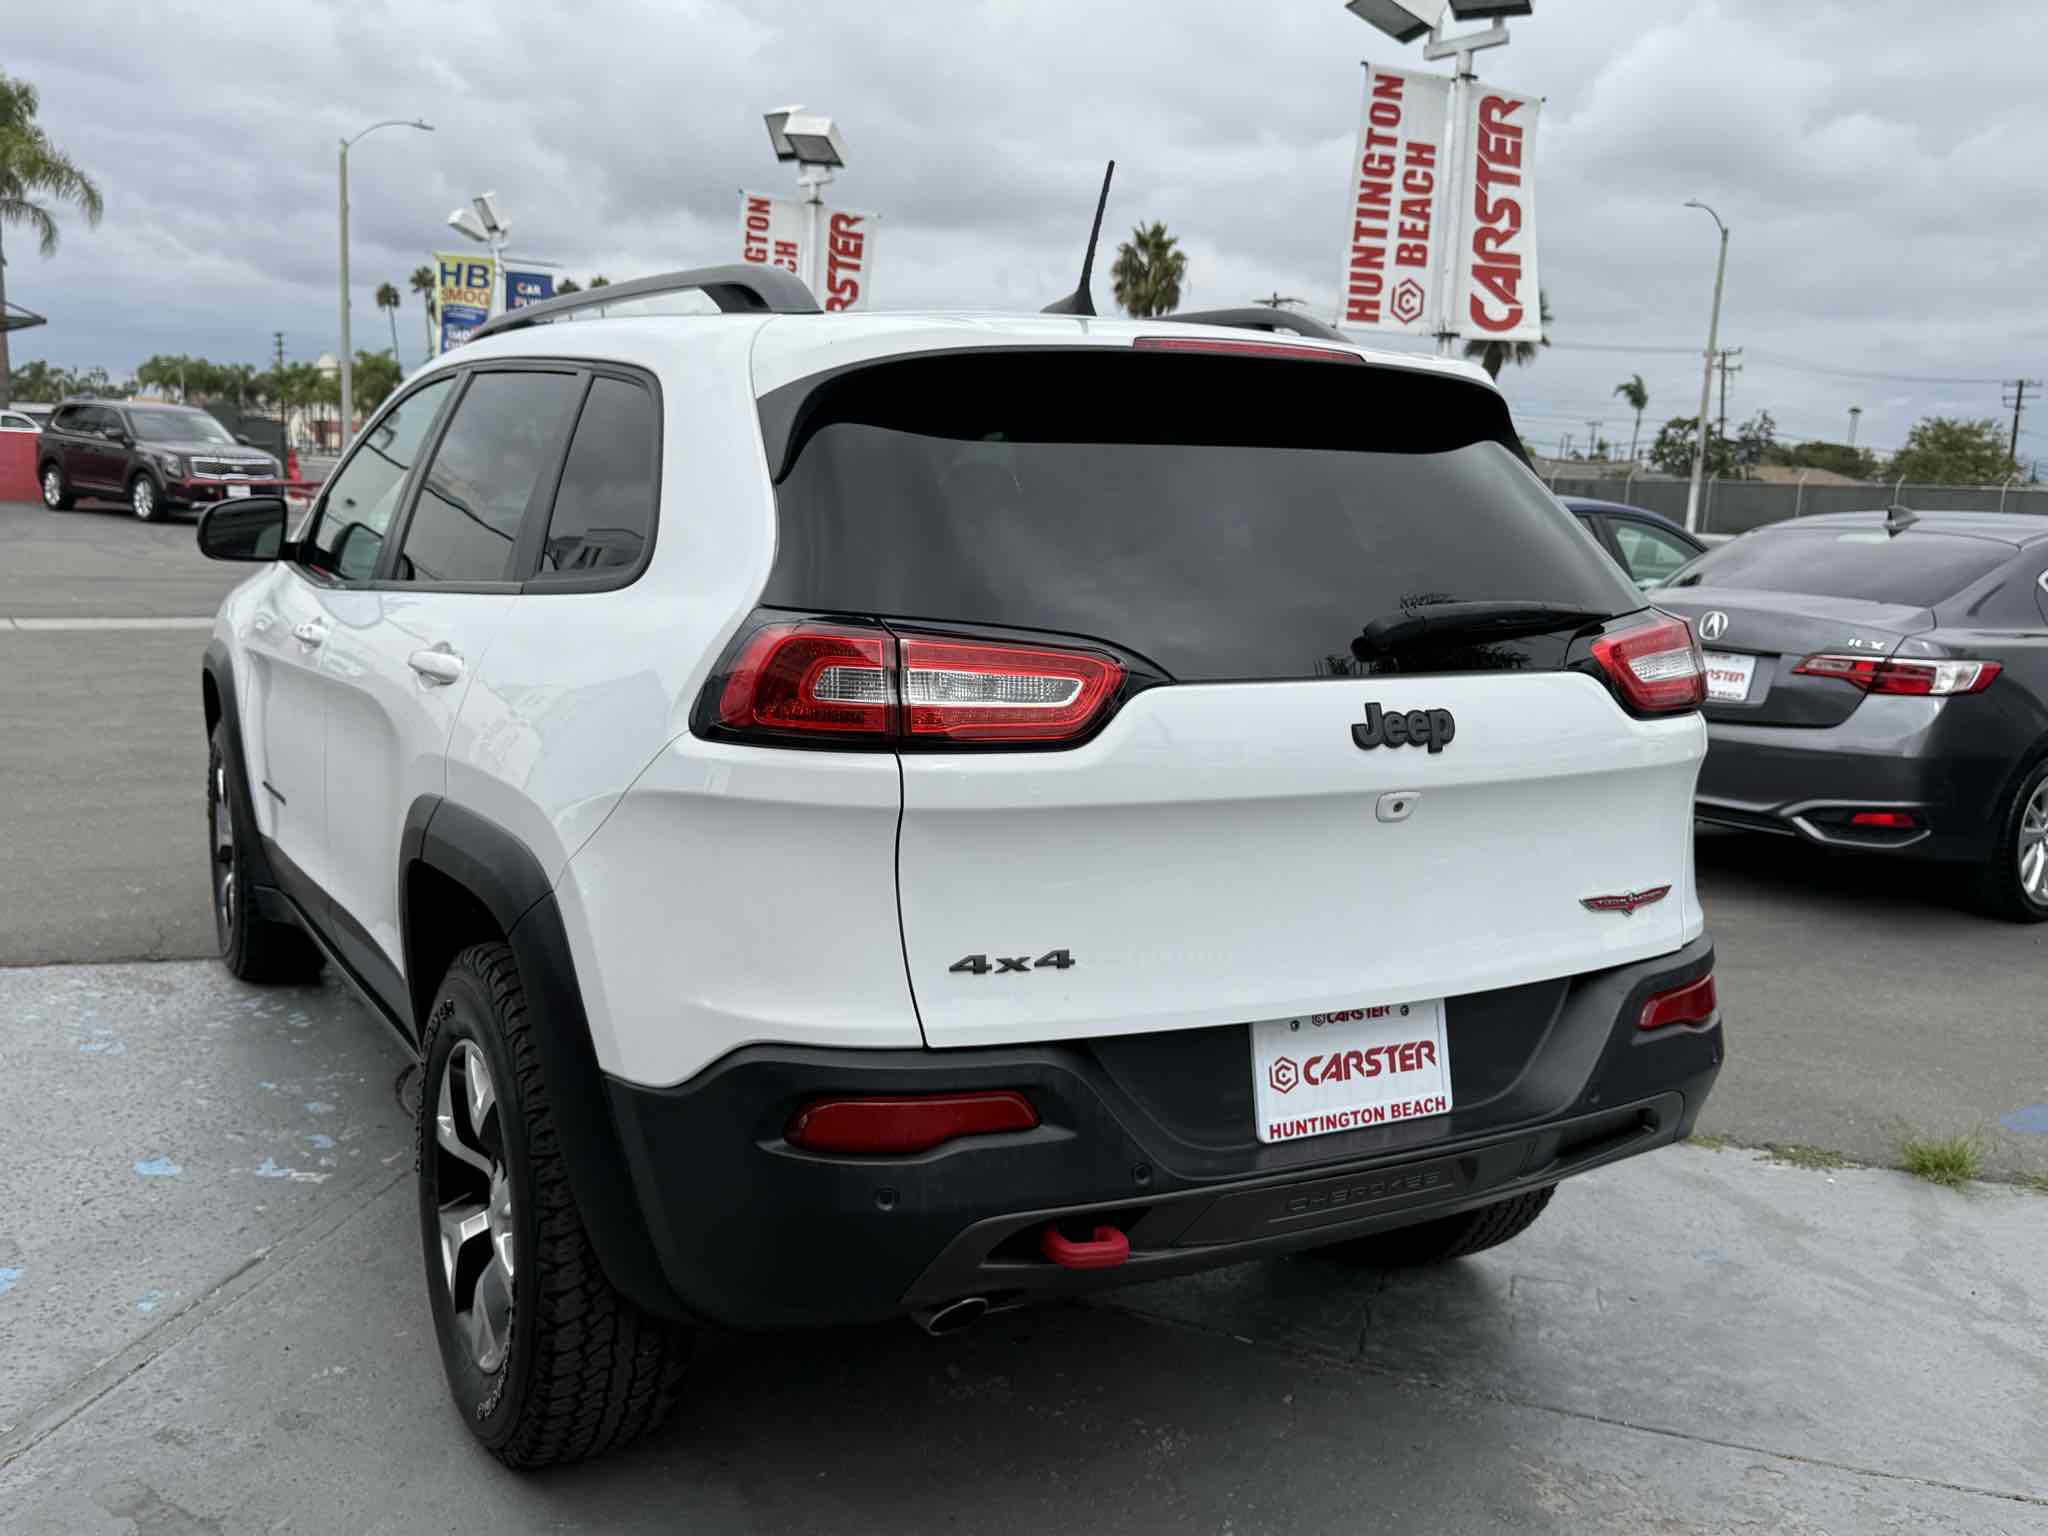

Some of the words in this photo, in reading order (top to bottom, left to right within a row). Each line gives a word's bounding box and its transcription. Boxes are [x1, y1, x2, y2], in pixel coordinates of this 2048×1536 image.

[1346, 74, 1405, 322] HUNTINGTON
[1395, 141, 1437, 268] BEACH
[1470, 95, 1525, 332] CARSTER
[440, 262, 490, 288] HB
[1351, 702, 1455, 754] Jeep
[949, 949, 1076, 975] 4x4
[1303, 1040, 1437, 1086] CARSTER
[1269, 1106, 1385, 1140] HUNTINGTON
[1390, 1095, 1447, 1119] BEACH
